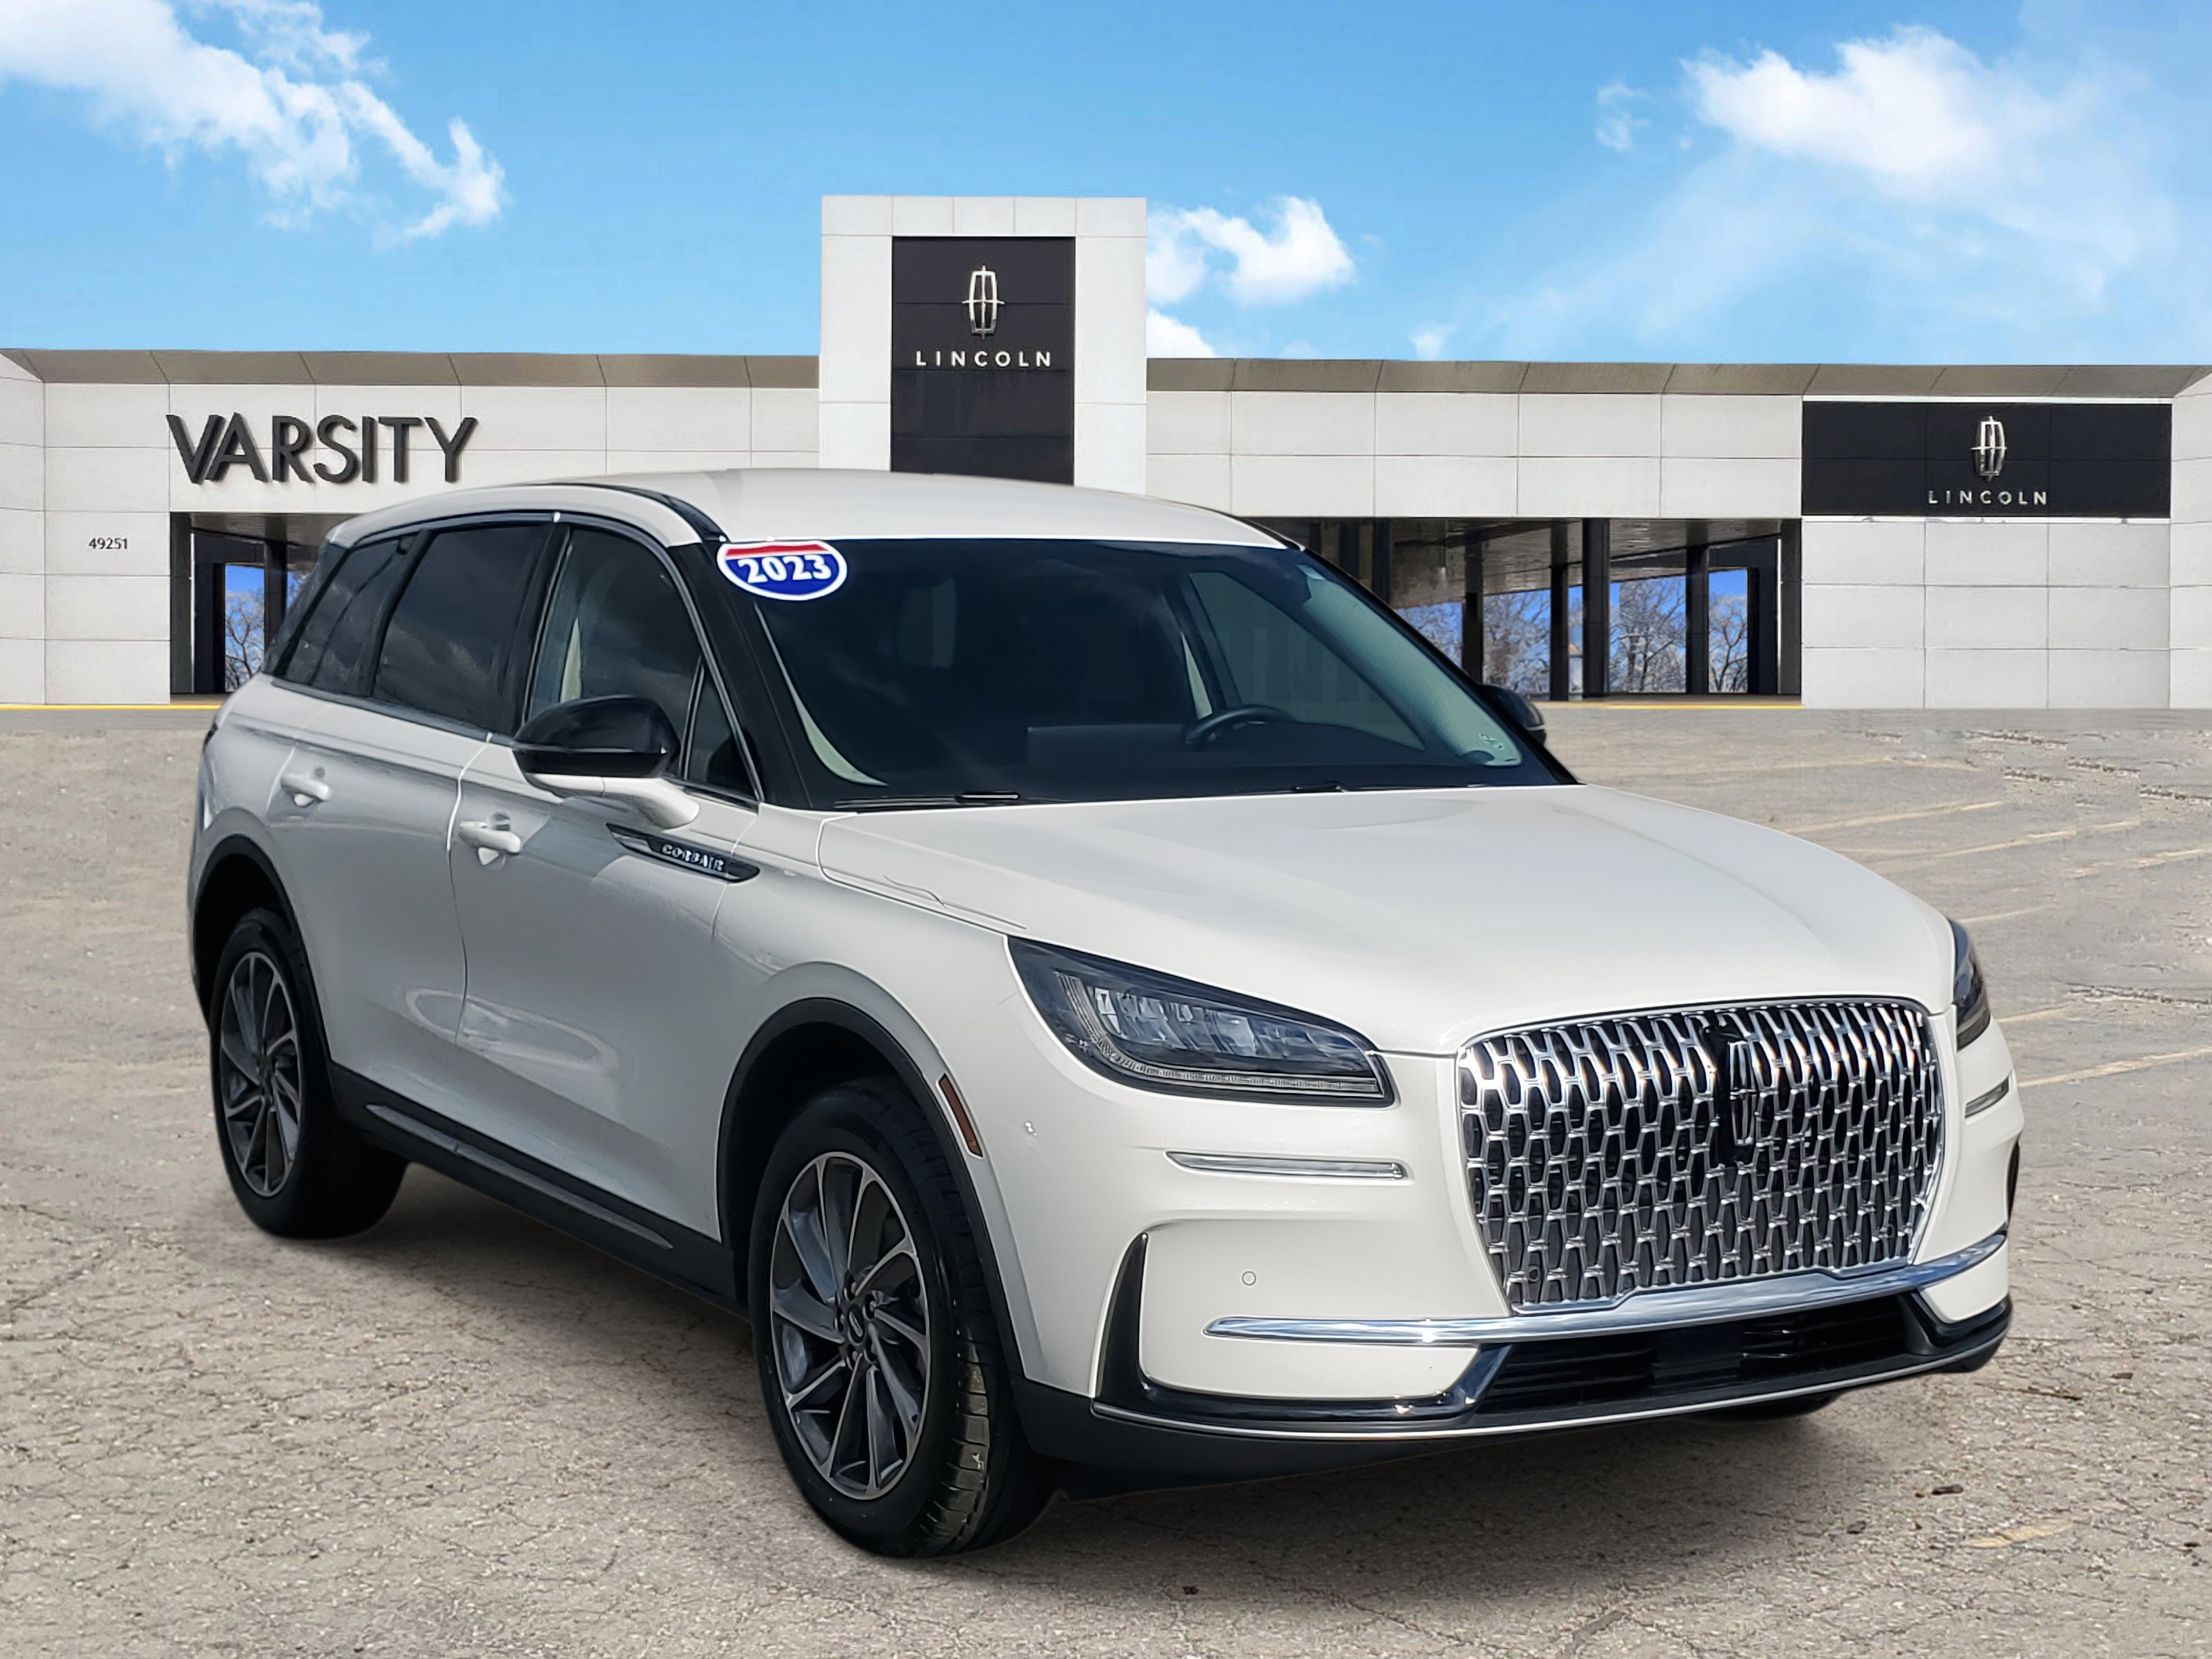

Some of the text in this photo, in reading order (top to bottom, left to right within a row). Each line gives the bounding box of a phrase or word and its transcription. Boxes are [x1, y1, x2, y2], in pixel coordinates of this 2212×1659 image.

[916, 350, 1051, 367] LINCOLN
[166, 412, 478, 484] VARSITY
[1928, 490, 2048, 505] LINCOLN
[88, 537, 128, 549] 49251
[737, 554, 831, 583] 2023
